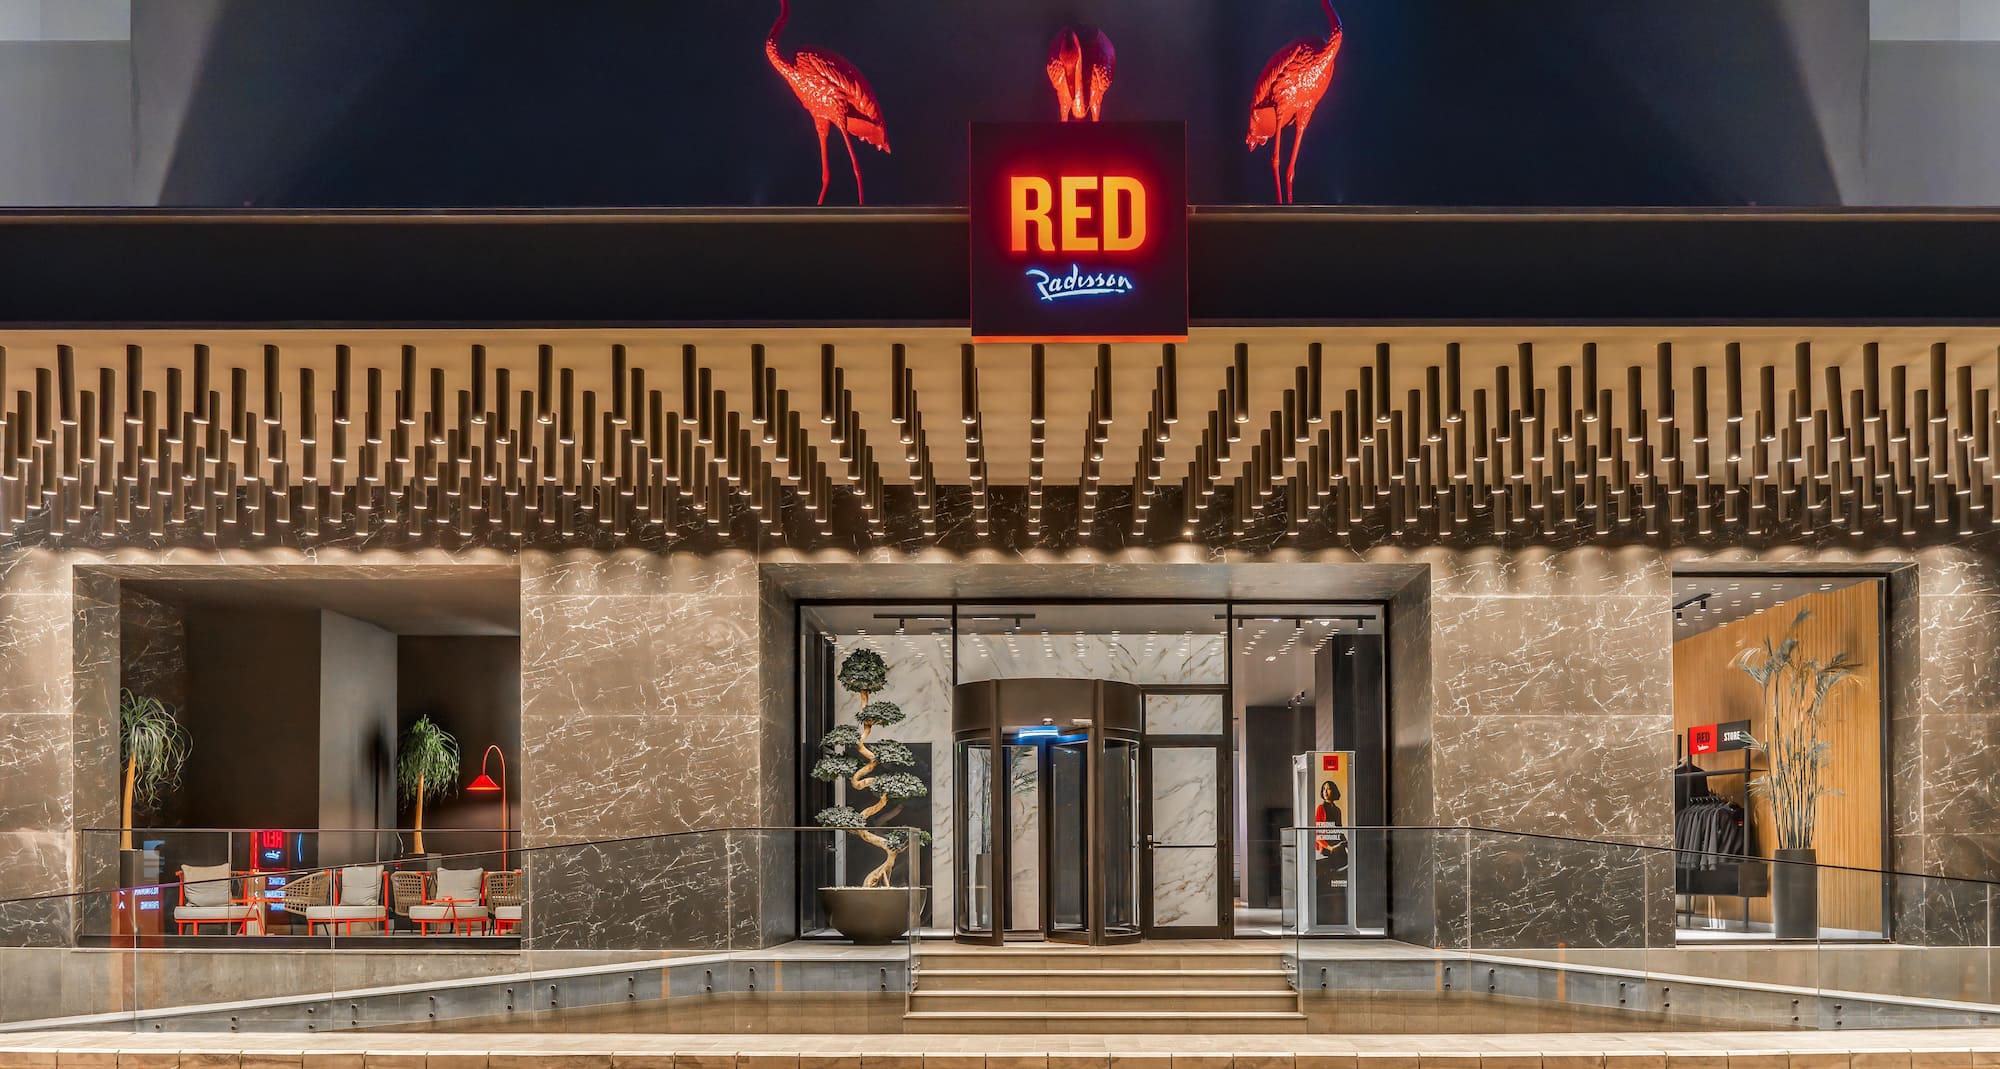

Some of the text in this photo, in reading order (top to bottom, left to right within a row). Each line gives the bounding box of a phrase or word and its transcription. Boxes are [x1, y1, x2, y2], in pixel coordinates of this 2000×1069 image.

[1010, 176, 1147, 252] RED
[1025, 263, 1133, 302] Radisson
[1696, 732, 1710, 744] RED
